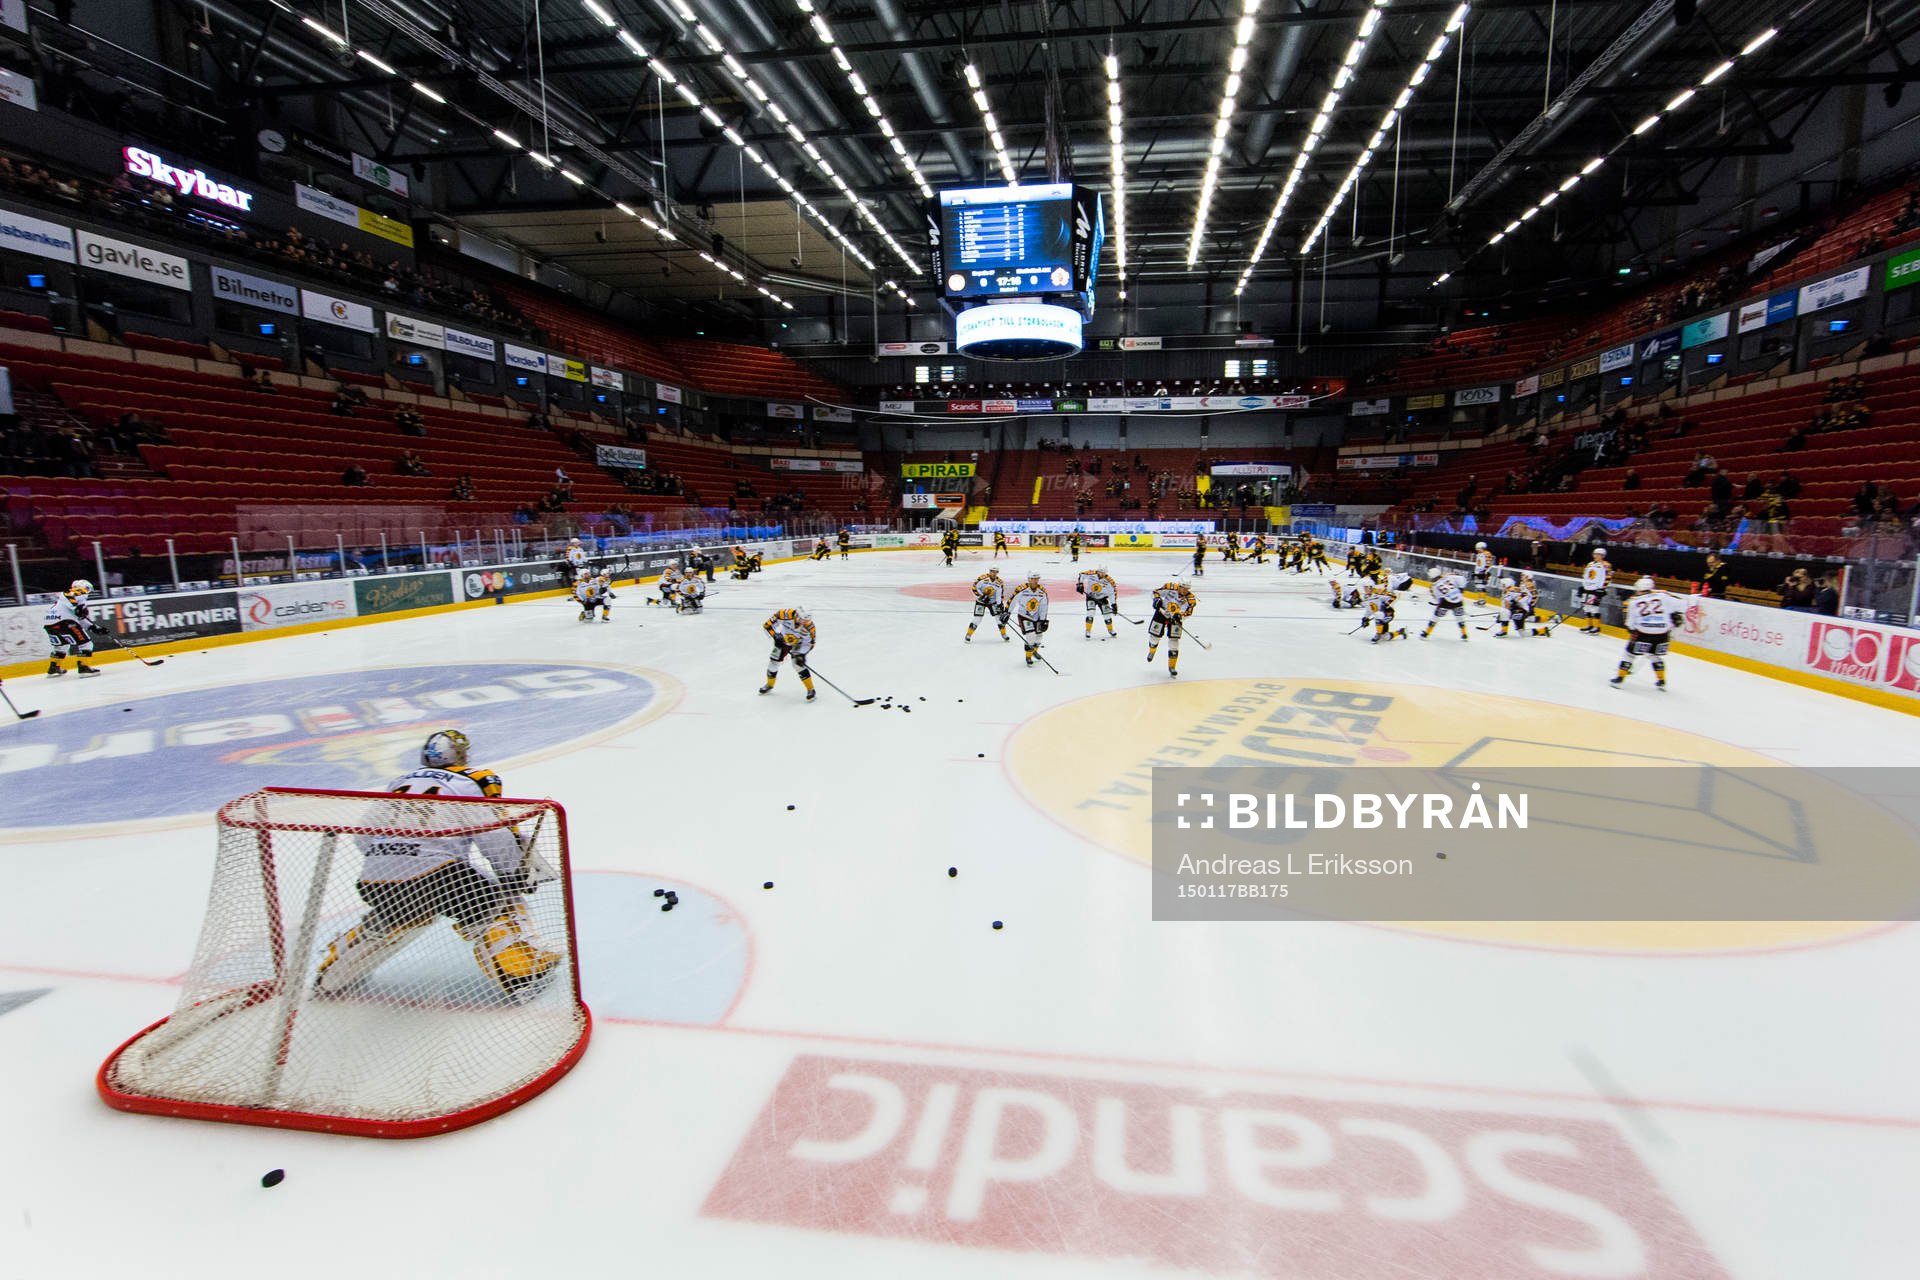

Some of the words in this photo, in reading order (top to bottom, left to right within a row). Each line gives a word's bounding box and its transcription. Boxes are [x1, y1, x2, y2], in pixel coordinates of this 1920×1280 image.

[122, 146, 252, 211] Skybar
[0, 223, 71, 250] sbanken
[87, 243, 184, 279] gavle.se
[1890, 259, 1920, 278] SEB
[217, 275, 294, 307] Bilmetro
[447, 333, 493, 351] BILBOLAGET
[507, 353, 538, 367] Nordea
[951, 403, 979, 411] Scandic
[919, 465, 969, 476] PIRAB
[911, 494, 928, 503] SFS
[223, 556, 285, 574] BSTRÖM
[88, 601, 153, 622] FFICE
[274, 600, 346, 617] calderys
[1636, 599, 1663, 616] 22
[1719, 621, 1785, 646] skfab.se
[1829, 660, 1876, 682] meal
[1074, 683, 1286, 810] BYGGMATERIAL
[787, 1073, 1647, 1276] Scandic
